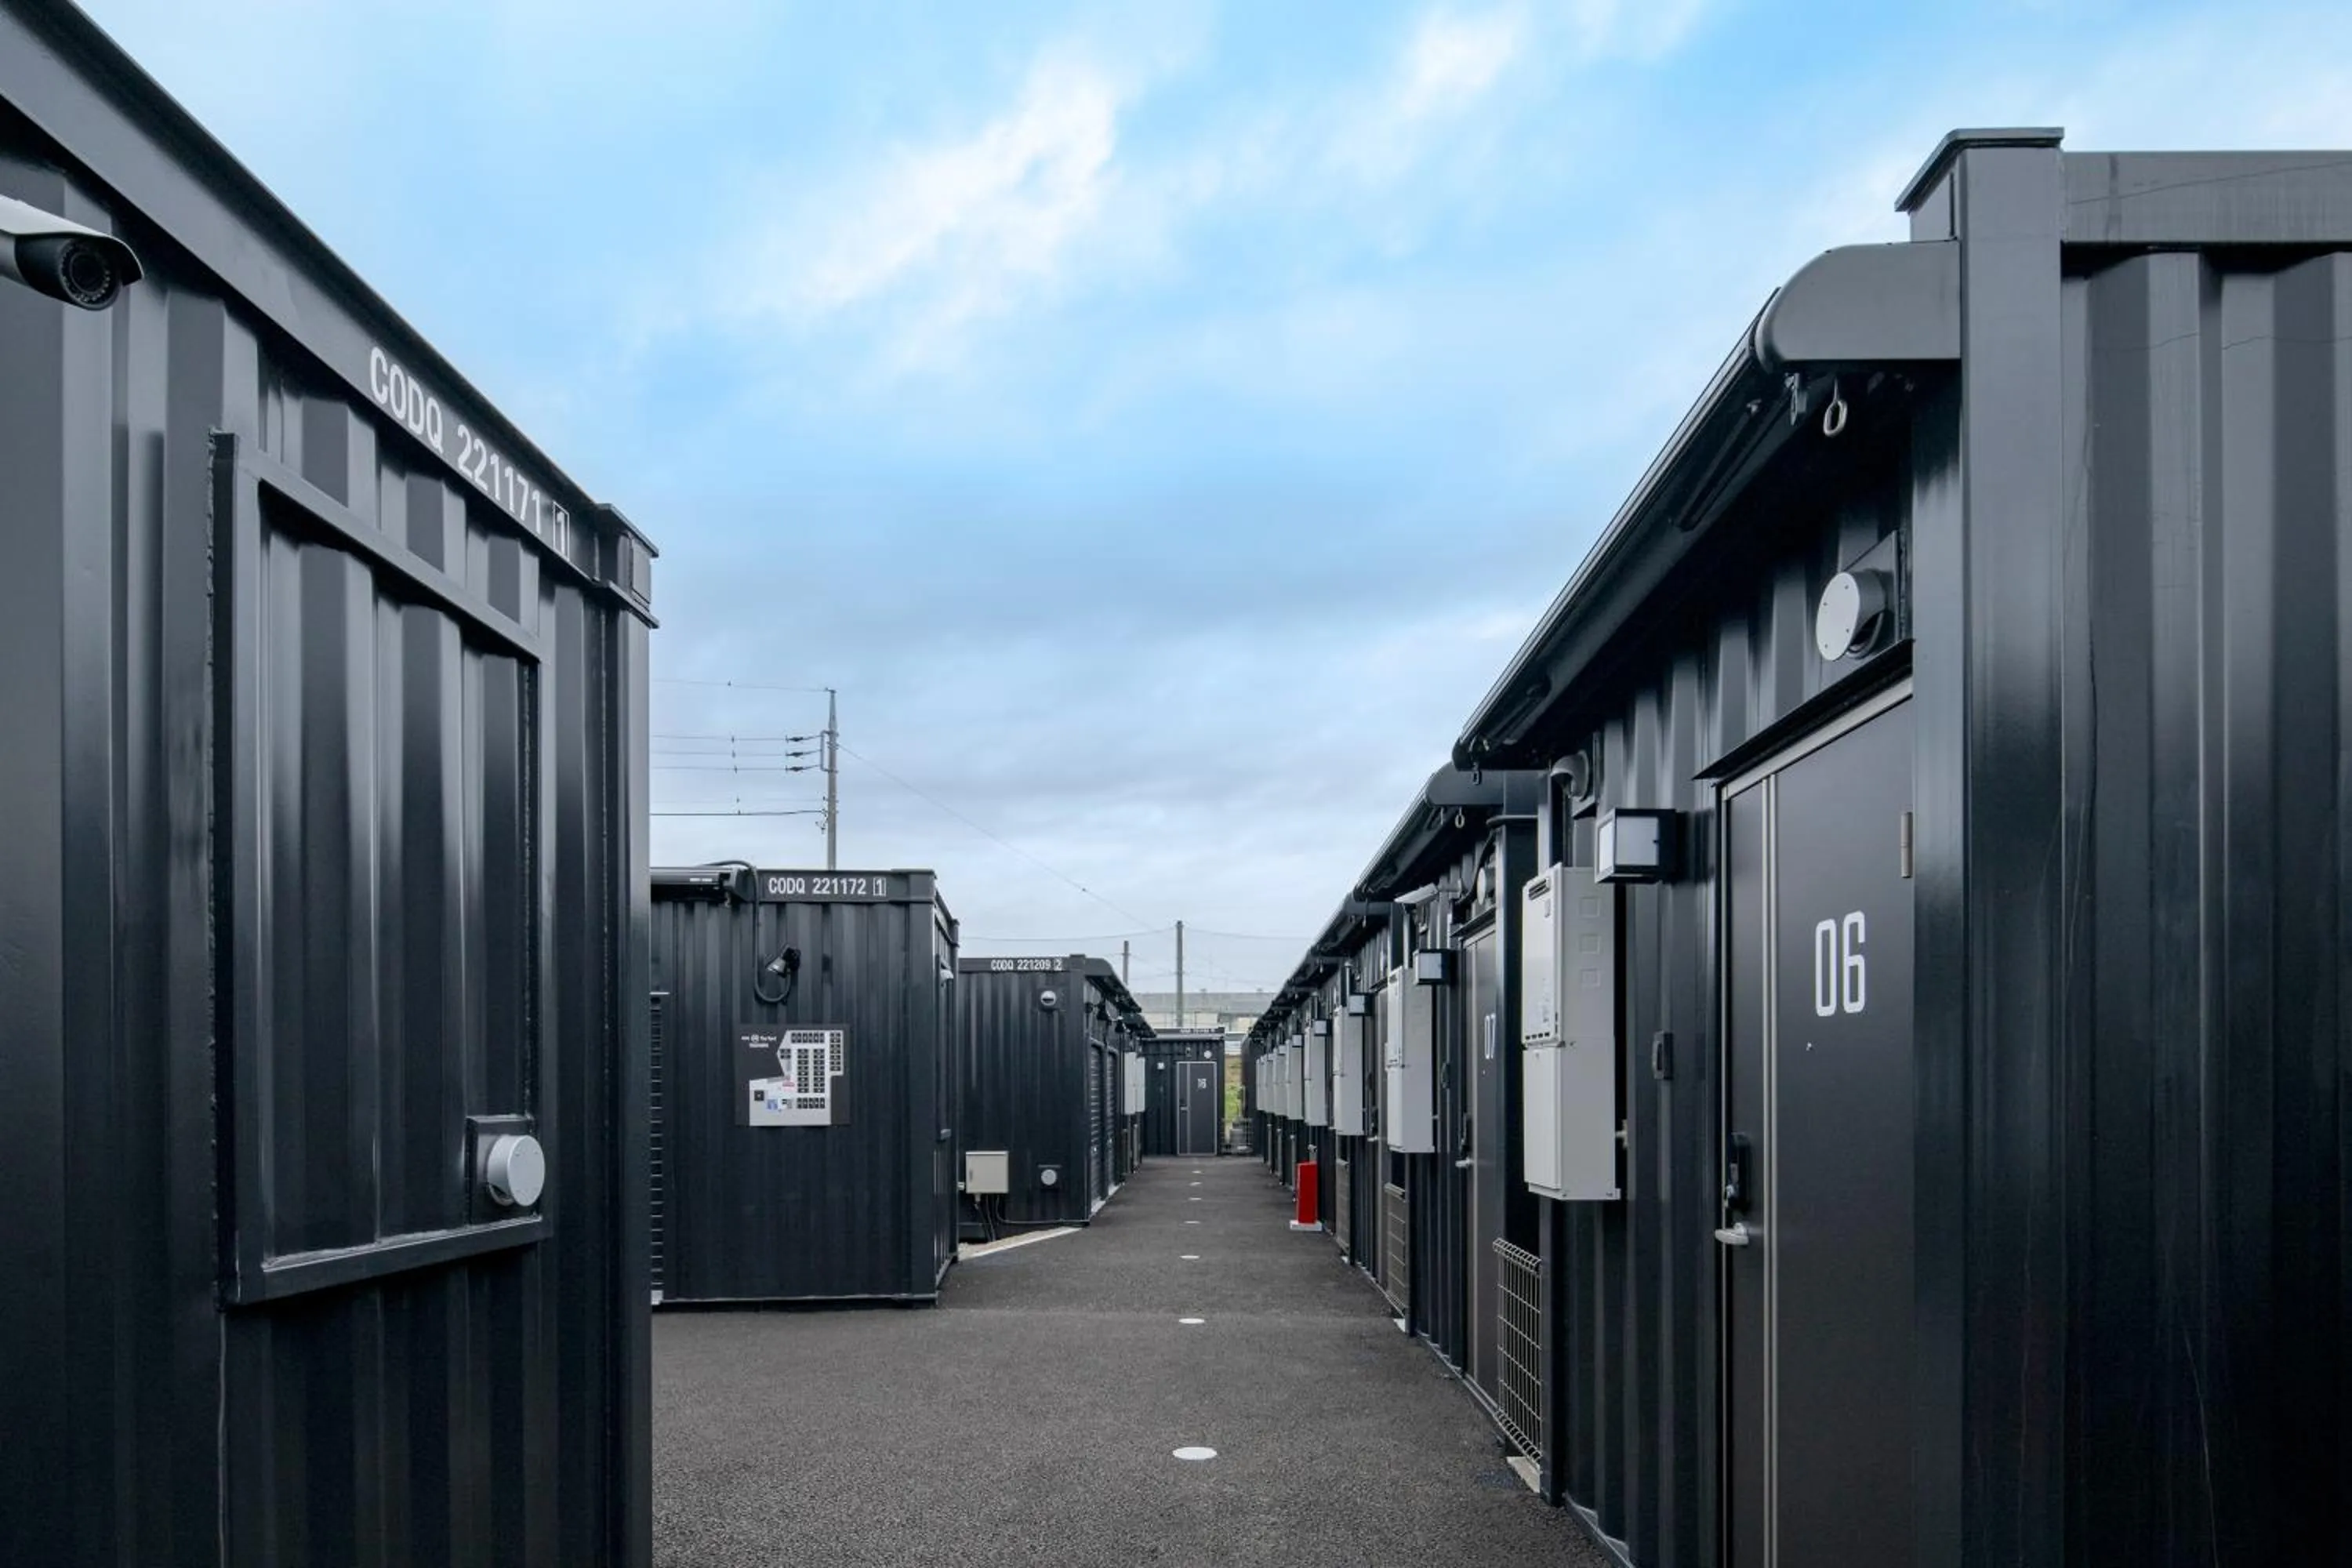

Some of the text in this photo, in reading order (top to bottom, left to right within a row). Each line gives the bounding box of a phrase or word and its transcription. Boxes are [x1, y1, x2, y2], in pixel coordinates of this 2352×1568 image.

[370, 347, 445, 455] CODQ
[457, 424, 541, 535] 221171
[768, 877, 806, 895] CODQ
[812, 877, 867, 895] 221172
[1815, 910, 1866, 1018] 06
